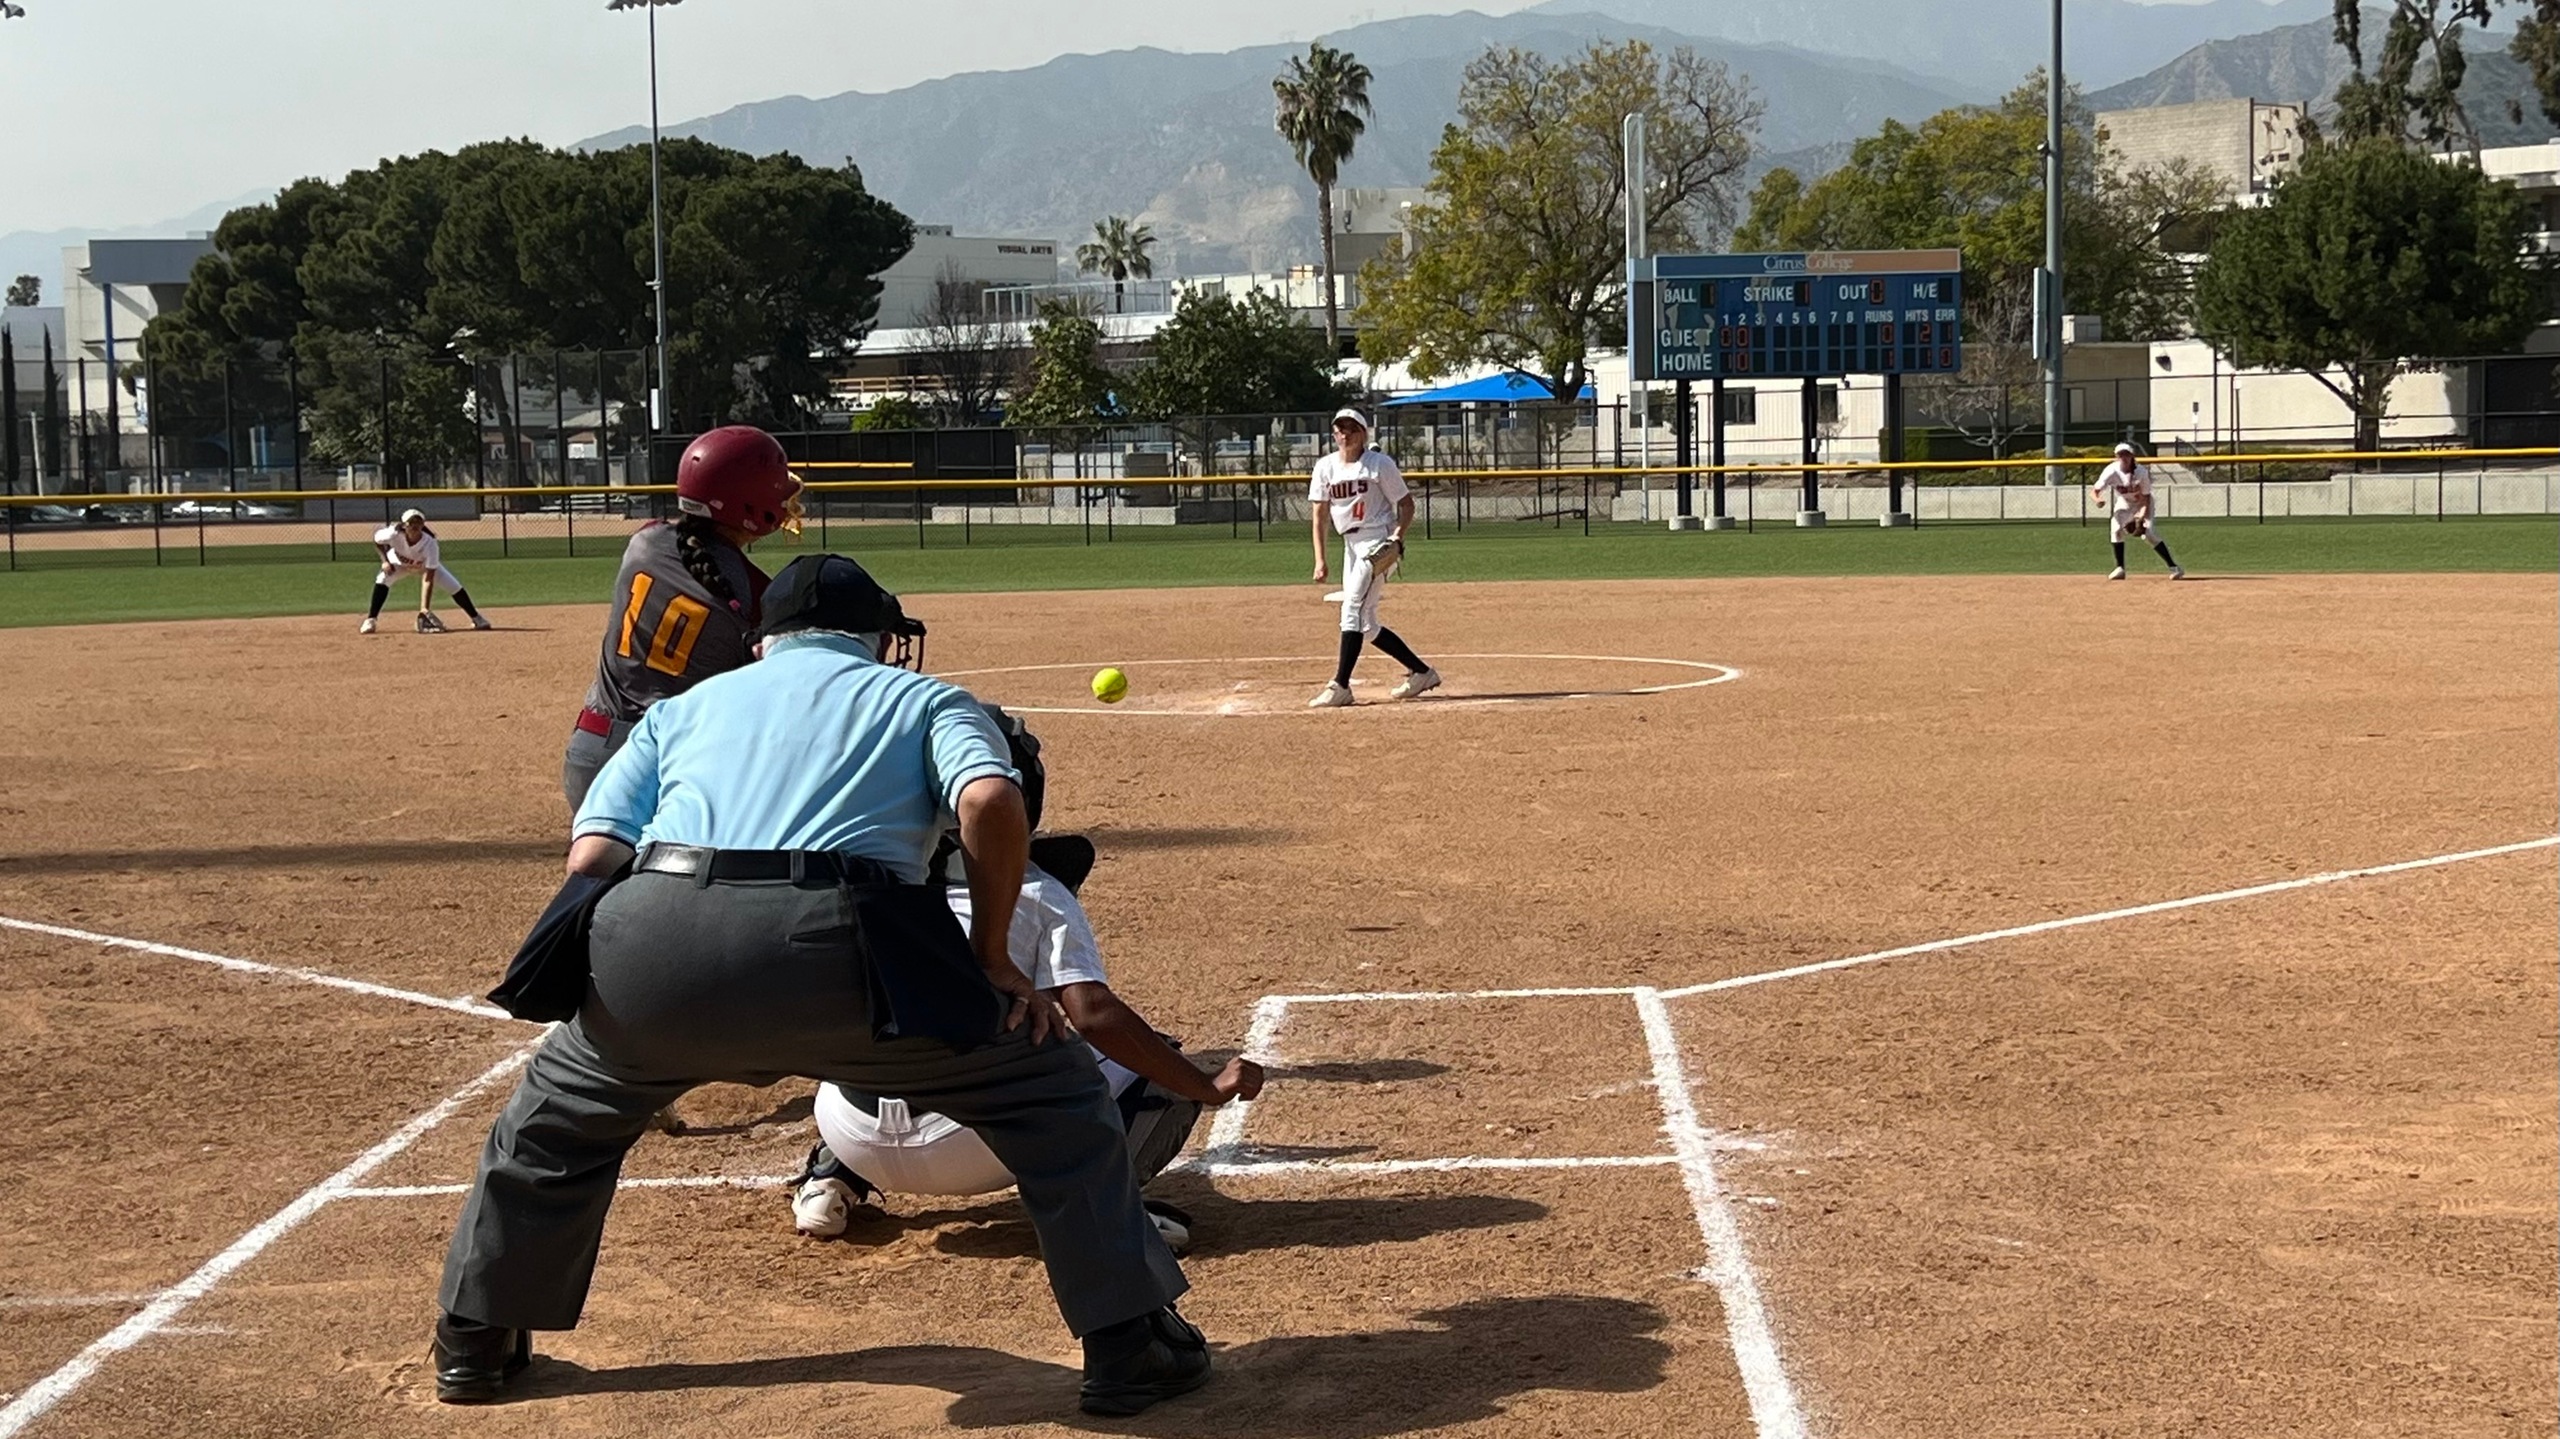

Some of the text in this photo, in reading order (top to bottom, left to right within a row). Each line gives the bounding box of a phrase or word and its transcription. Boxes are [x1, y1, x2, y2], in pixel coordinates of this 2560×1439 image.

[997, 245, 1052, 254] VISUAL ARTS
[1763, 253, 1854, 272] Citrus College
[1663, 288, 1697, 303] BALL
[1743, 286, 1794, 302] STRIKE
[1839, 284, 1868, 300] OUT
[1912, 282, 1938, 299] H/E
[1723, 308, 1956, 326] 1 2 3 4 5 6 7 8 RUNS HITS ERR
[1662, 353, 1713, 371] HOME
[1353, 501, 1365, 521] 4
[616, 571, 711, 677] 10
